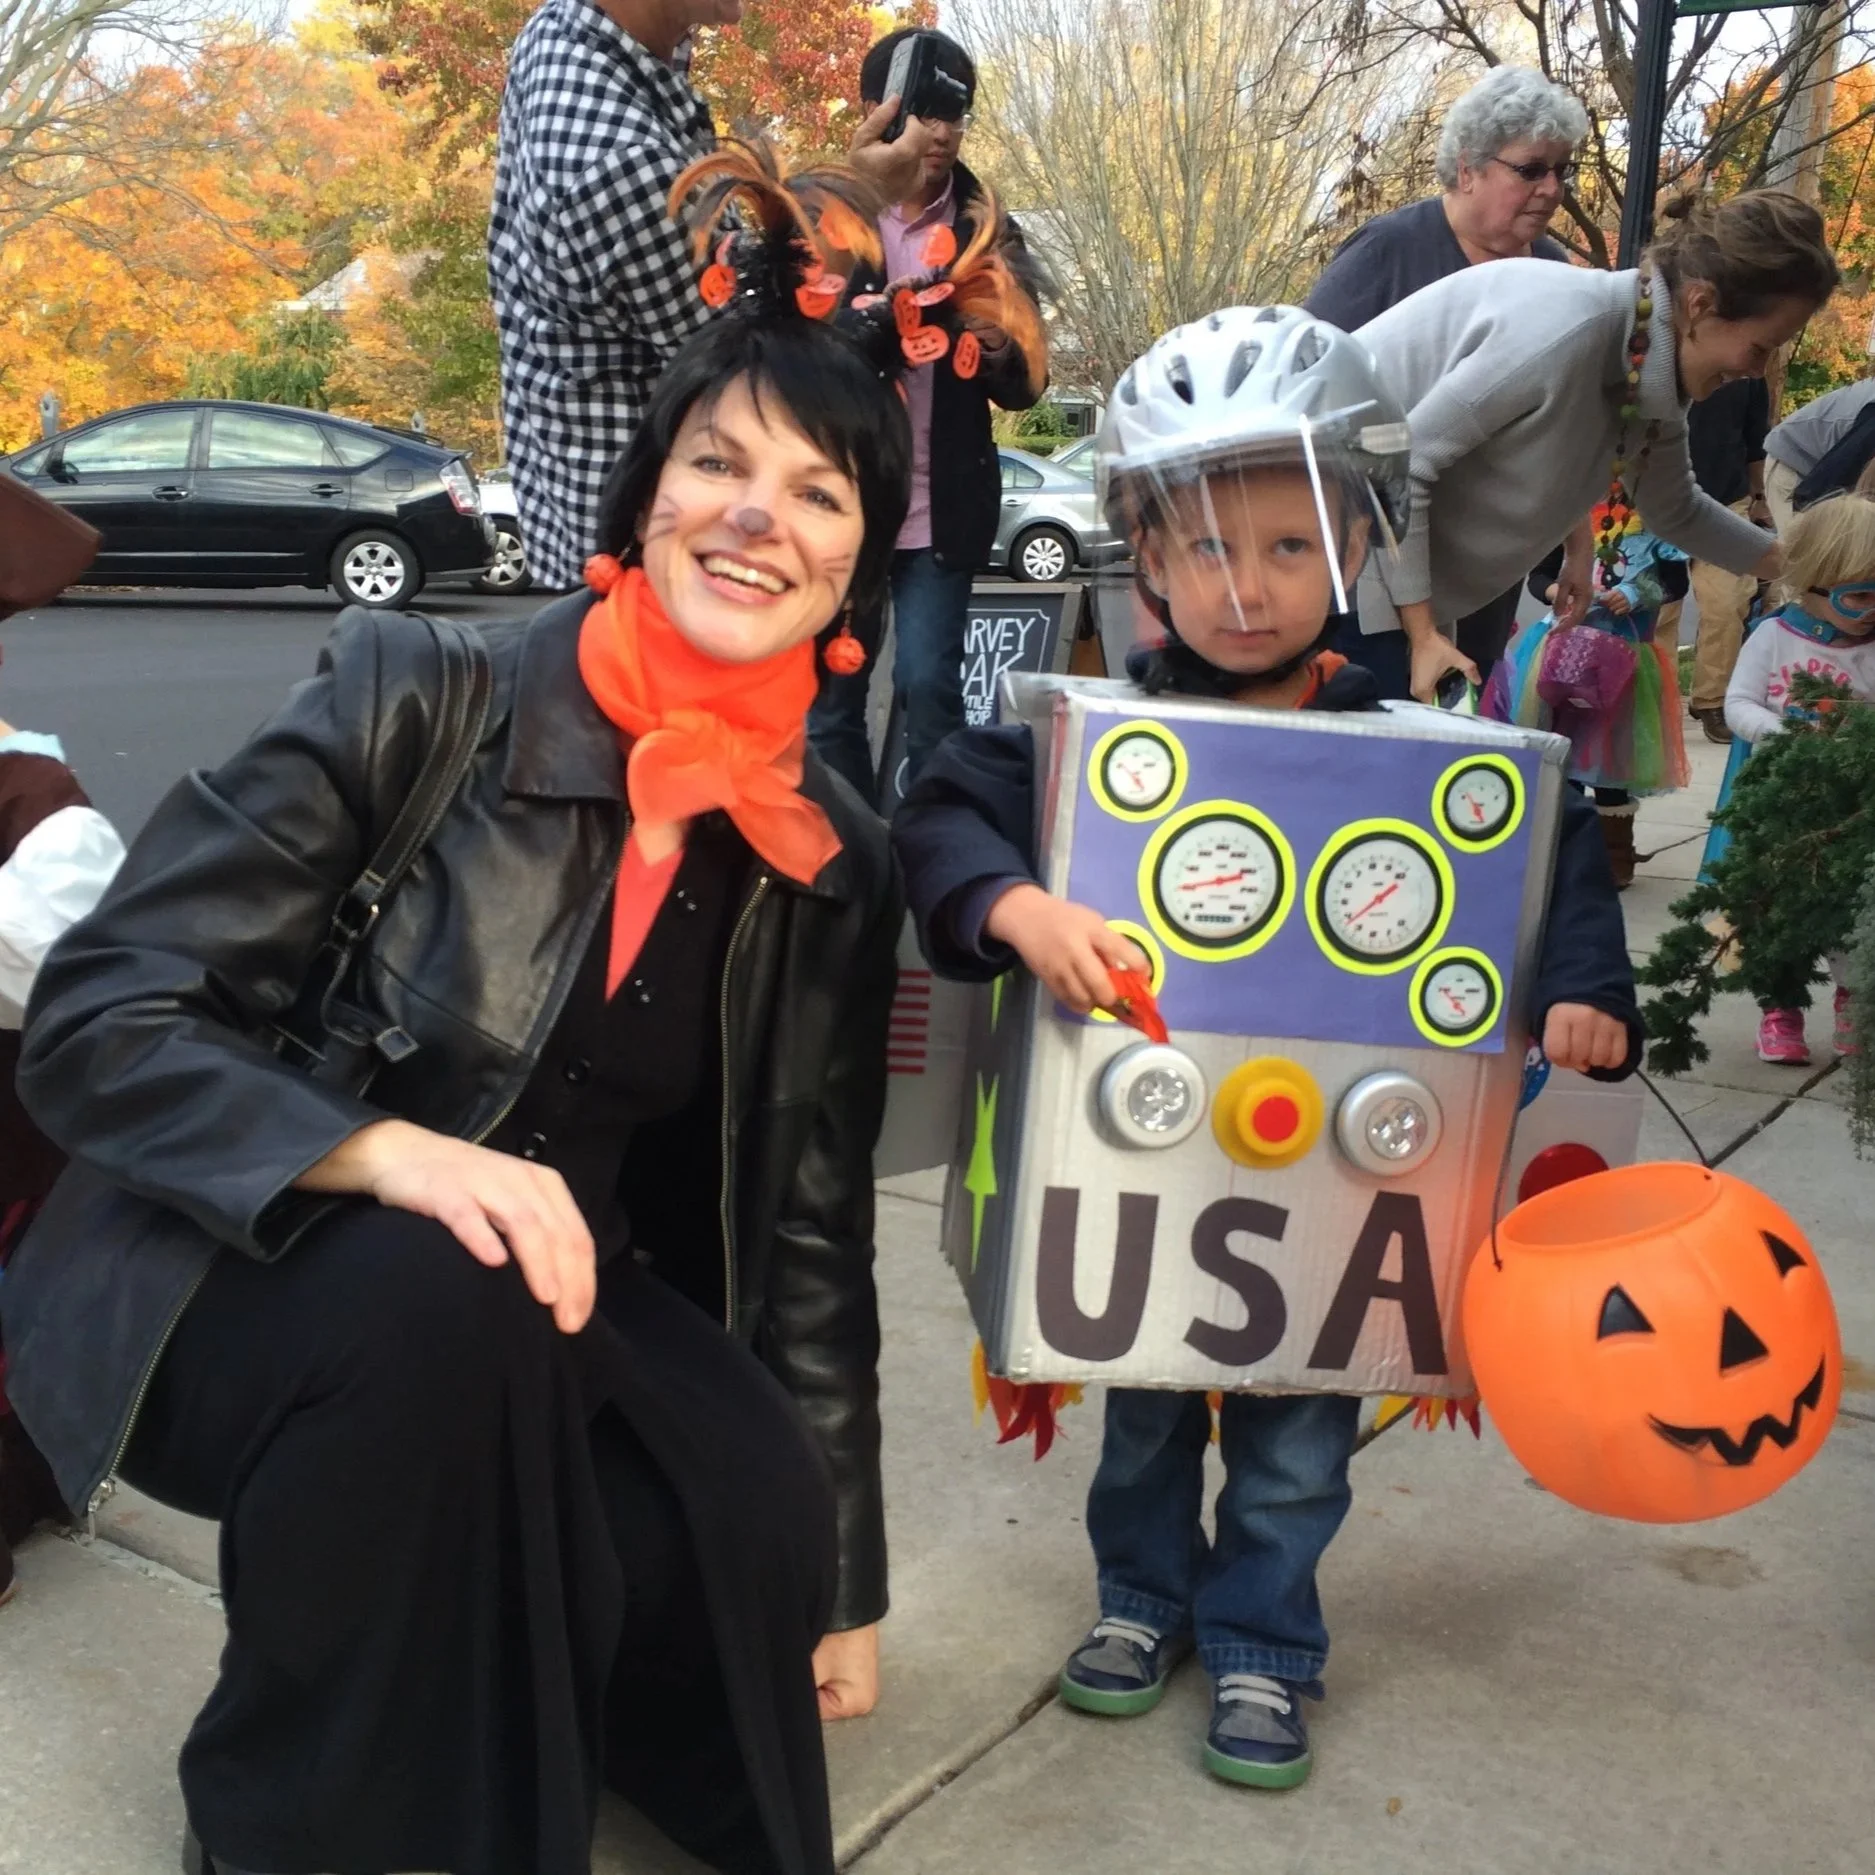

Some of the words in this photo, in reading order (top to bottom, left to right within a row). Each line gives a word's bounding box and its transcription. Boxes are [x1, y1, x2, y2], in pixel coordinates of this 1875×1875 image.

[960, 652, 1024, 698] AK
[964, 695, 994, 710] TILE
[1036, 1186, 1449, 1375] USA
